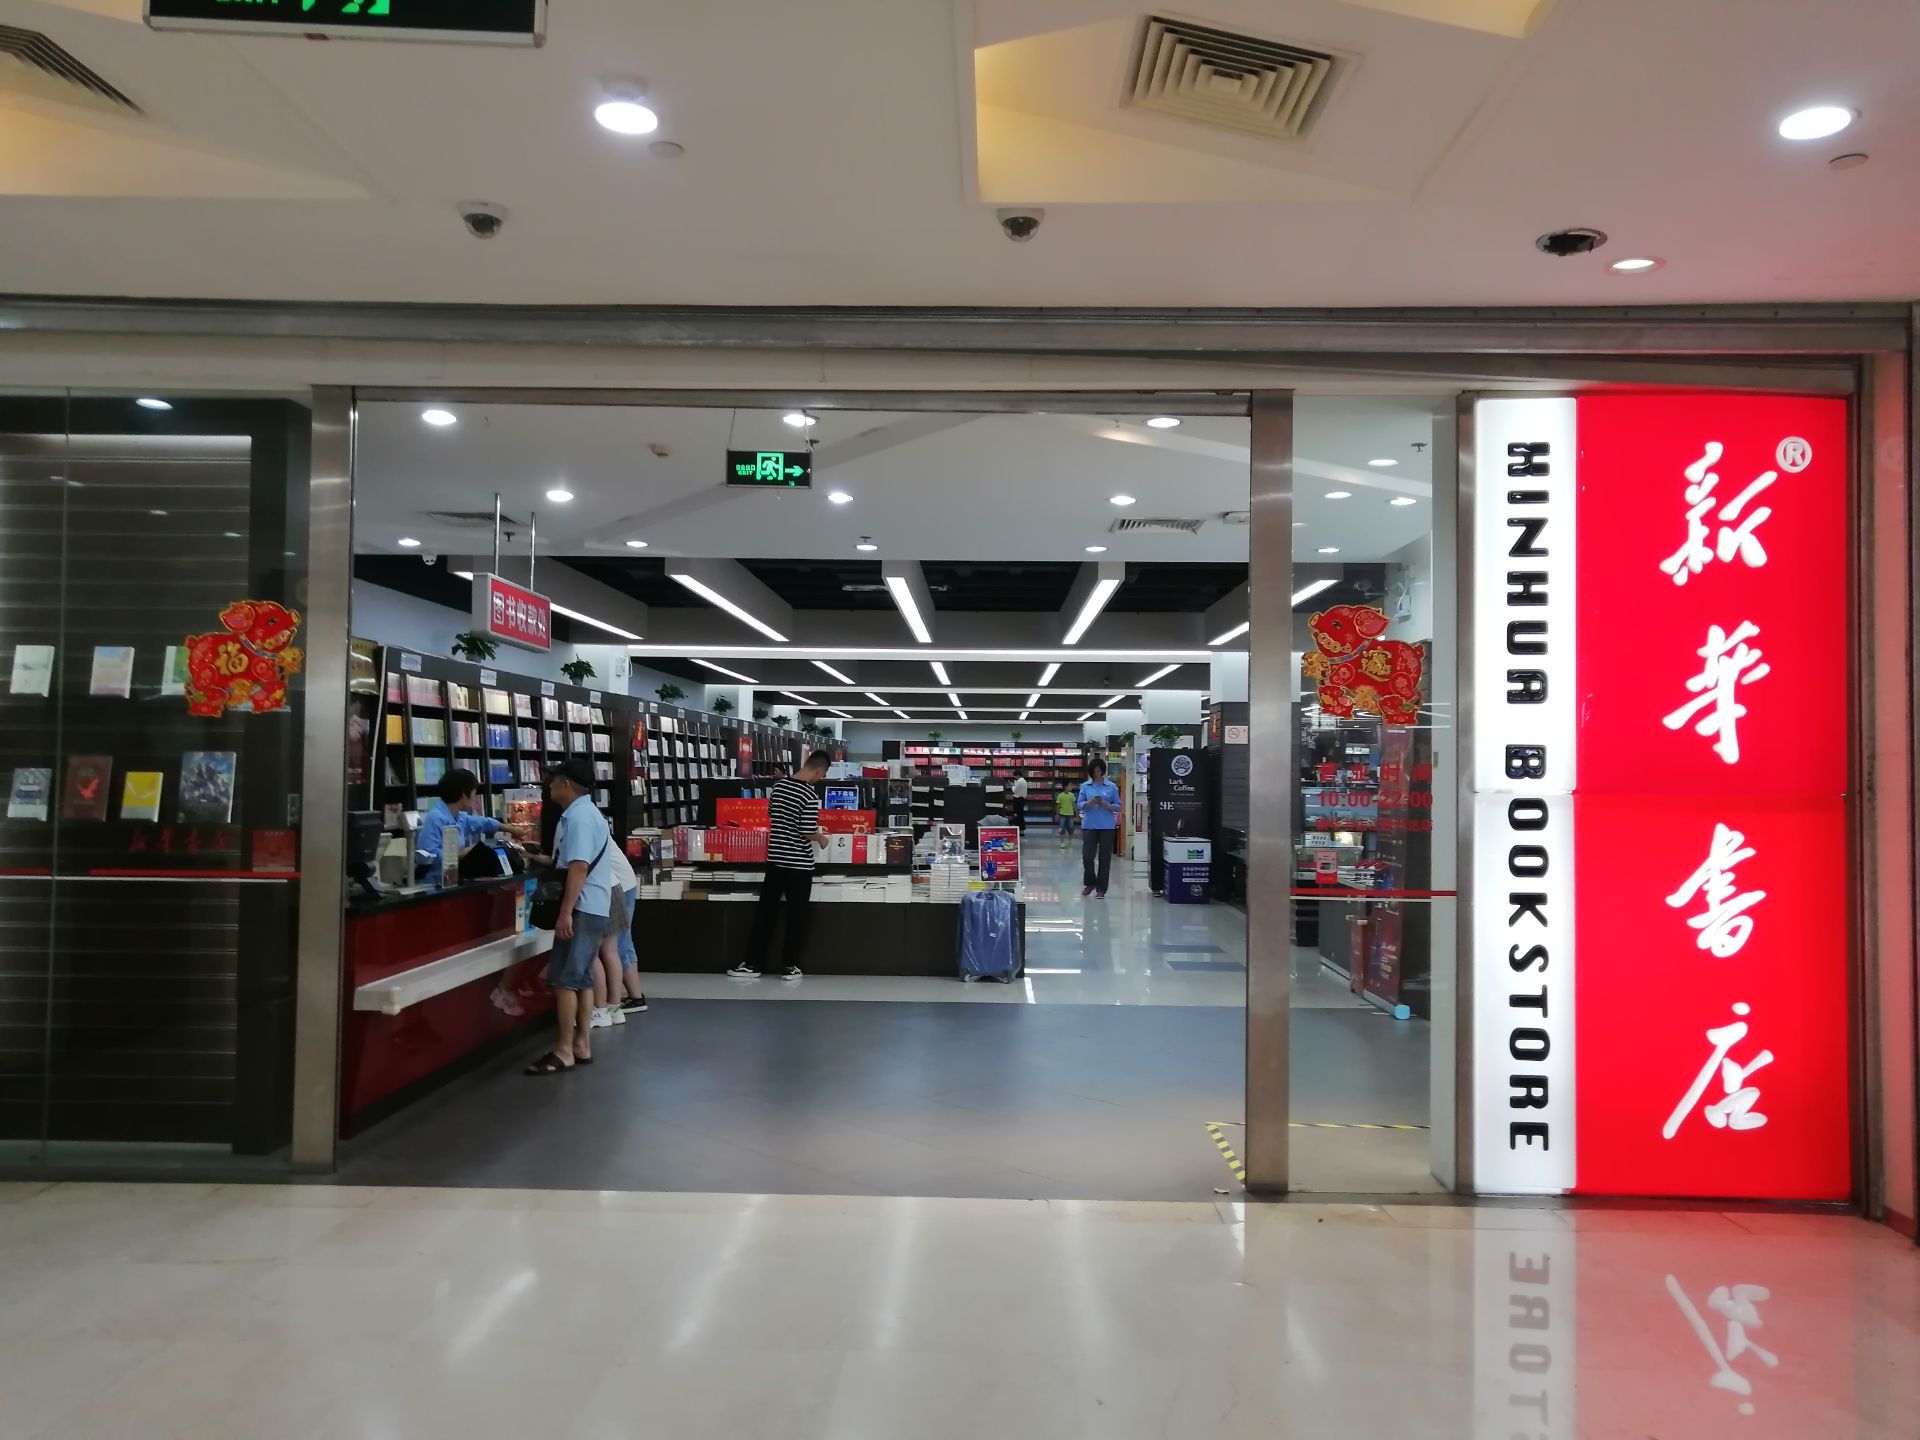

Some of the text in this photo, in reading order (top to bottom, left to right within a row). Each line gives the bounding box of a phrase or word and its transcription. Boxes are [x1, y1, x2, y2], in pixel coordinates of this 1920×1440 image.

[493, 591, 547, 639] 图书收款处
[214, 641, 249, 676] 福
[1505, 441, 1551, 1152] XINHUA BOOKSTORE
